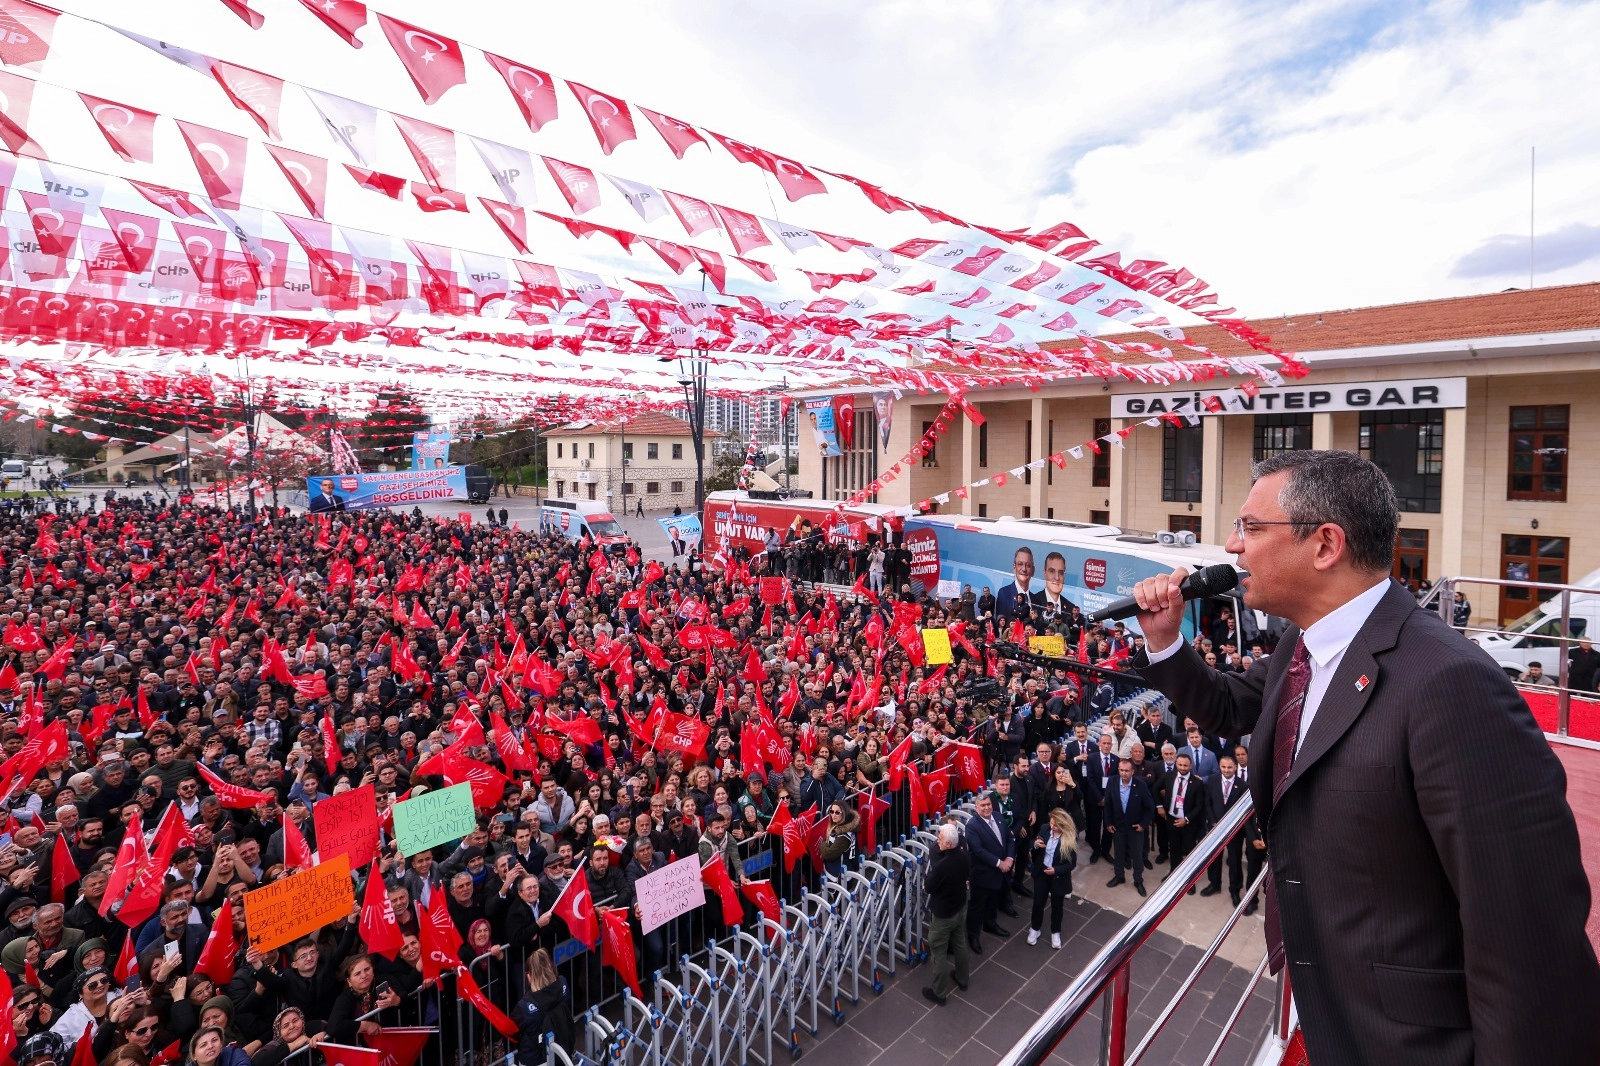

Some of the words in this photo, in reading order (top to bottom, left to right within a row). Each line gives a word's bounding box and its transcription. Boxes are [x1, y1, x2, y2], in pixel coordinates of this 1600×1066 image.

[157, 265, 189, 277] CHP
[224, 276, 248, 287] CHP
[282, 281, 310, 292] CHP
[670, 326, 687, 334] CHP
[1346, 386, 1439, 406] GAR
[362, 473, 386, 483] SAYIN
[388, 472, 413, 480] GENEL
[378, 481, 400, 491] GAZİ
[373, 488, 454, 504] HOŞGELDİNİZ
[744, 525, 765, 541] VAR
[909, 553, 937, 564] ÜCÜMÜZ
[673, 735, 693, 748] CHP
[647, 875, 660, 889] NE
[665, 862, 694, 882] KADAR
[665, 885, 696, 905] KADAR
[249, 901, 287, 922] FATMA
